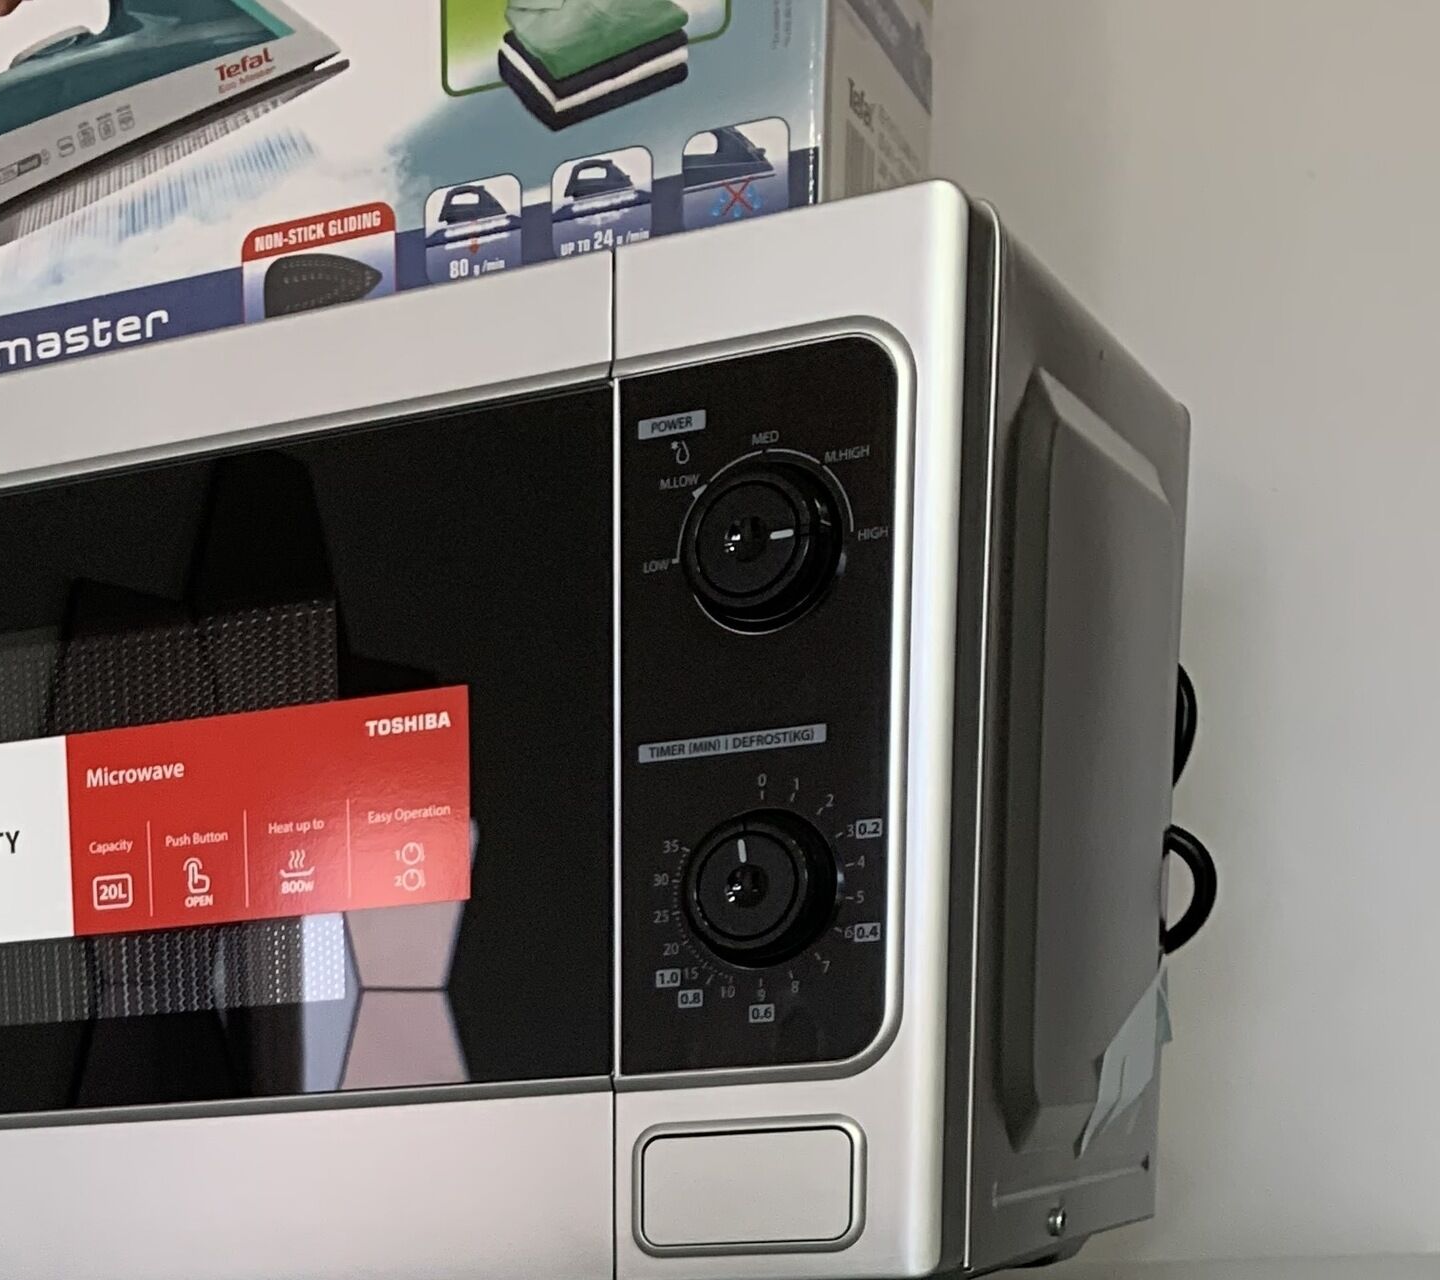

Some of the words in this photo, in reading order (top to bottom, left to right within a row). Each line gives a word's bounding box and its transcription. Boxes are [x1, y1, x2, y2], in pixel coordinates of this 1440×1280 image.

[215, 47, 274, 80] Tefal
[255, 222, 325, 252] NON-STICK
[328, 210, 381, 236] GLIDING
[561, 242, 574, 256] UP
[578, 239, 590, 252] TO
[593, 229, 613, 249] 24
[449, 258, 468, 278] 80
[482, 259, 505, 272] /min
[651, 416, 692, 433] POWER
[751, 431, 779, 446] MED
[825, 445, 870, 462] M.HIGH
[660, 474, 700, 489] M.LOW
[858, 526, 888, 541] HIGH
[643, 561, 669, 574] LOW
[365, 711, 451, 737] TOSHIBA
[649, 746, 685, 759] TIMER
[733, 729, 814, 749] DEFROST(KG)
[86, 761, 185, 788] Microwave
[758, 774, 767, 787] 0
[826, 794, 834, 807] 2
[367, 810, 391, 824] Easy
[393, 804, 451, 823] Operation
[268, 822, 294, 834] Heat
[298, 821, 310, 834] up
[312, 820, 324, 831] to
[847, 825, 854, 838] 3
[859, 822, 880, 835] 0.2
[165, 834, 193, 848] Push
[195, 830, 229, 845] Button
[89, 839, 133, 856] Capacity
[663, 840, 679, 854] 35
[857, 855, 865, 868] 4
[653, 874, 669, 886] 30
[99, 886, 127, 900] 20L
[856, 890, 864, 903] 5
[185, 894, 213, 907] OPEN
[653, 910, 670, 923] 25
[856, 924, 879, 939] 0.4
[663, 943, 679, 956] 20
[822, 961, 830, 973] 7
[658, 972, 679, 984] 1.0
[684, 967, 699, 980] 15
[720, 985, 736, 998] 10
[791, 980, 799, 993] 8
[680, 992, 701, 1005] 0.8
[757, 988, 766, 1001] 9
[751, 1007, 772, 1020] 0.6
